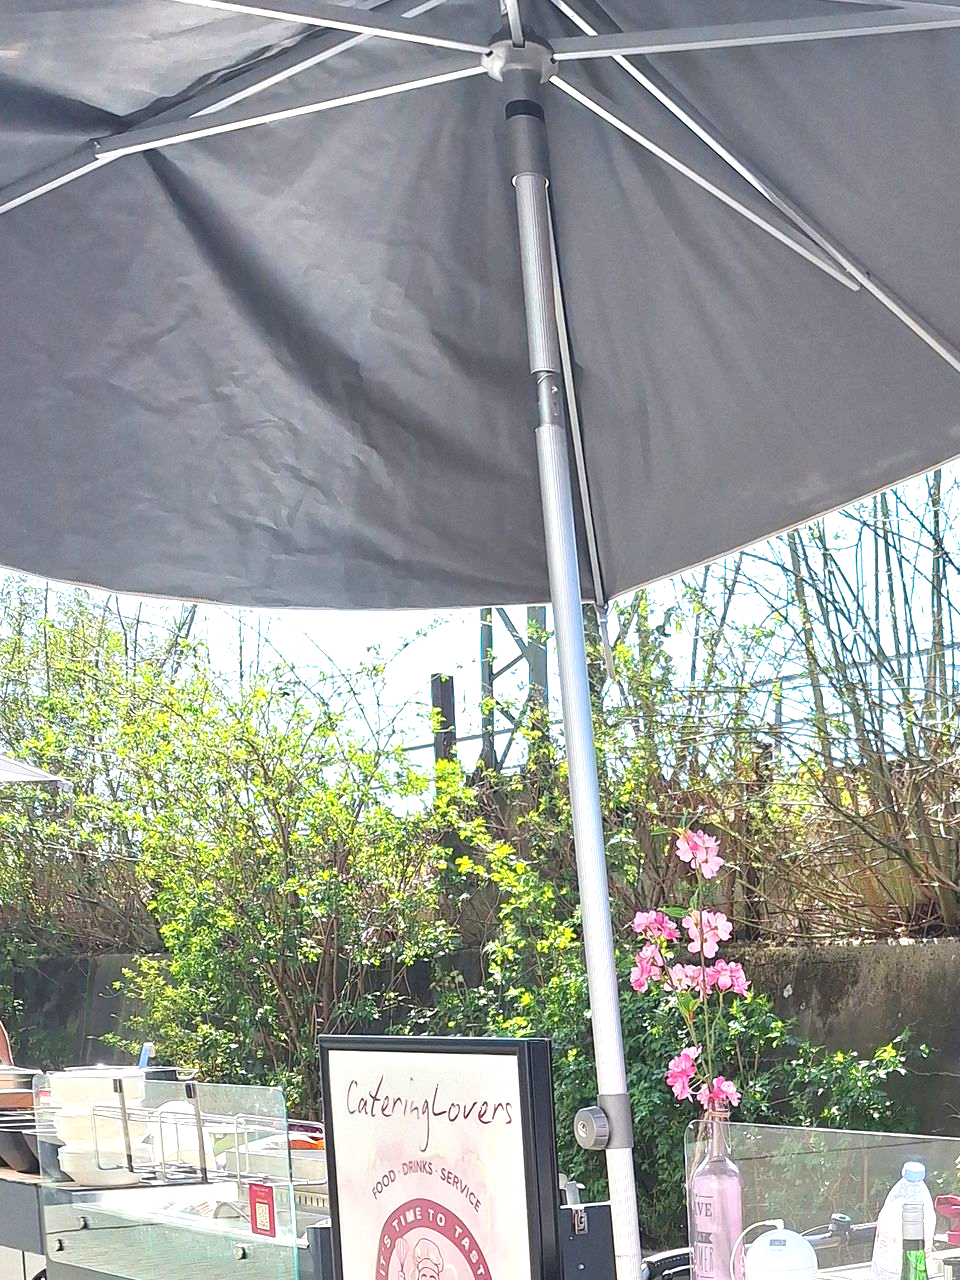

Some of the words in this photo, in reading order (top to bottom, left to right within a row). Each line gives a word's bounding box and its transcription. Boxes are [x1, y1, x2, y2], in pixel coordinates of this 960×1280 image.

[346, 1075, 512, 1152] CateringLovers
[371, 1169, 397, 1201] FOOD
[402, 1160, 433, 1176] DRINKS
[440, 1168, 482, 1213] SERVICE
[379, 1235, 391, 1276] IT'S
[392, 1207, 422, 1231] TIME
[427, 1208, 446, 1227] TO
